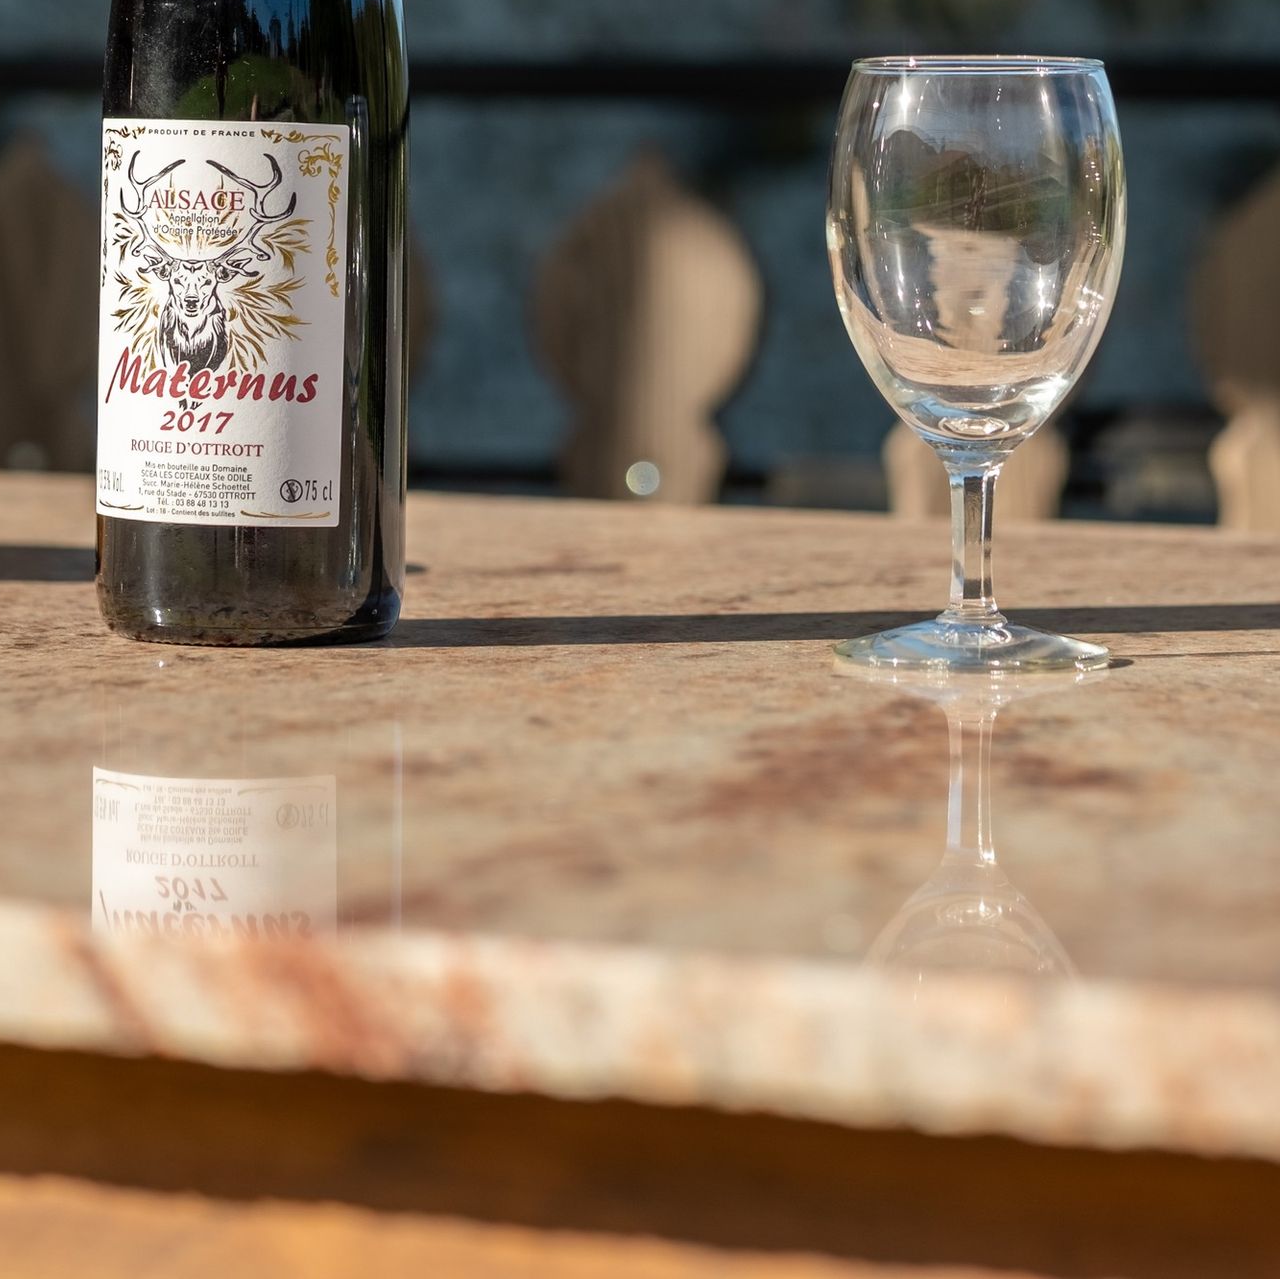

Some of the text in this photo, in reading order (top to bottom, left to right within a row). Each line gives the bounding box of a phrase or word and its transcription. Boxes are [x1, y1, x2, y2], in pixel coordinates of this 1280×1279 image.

[148, 190, 245, 211] ALSACE
[169, 214, 219, 224] Appellation
[197, 226, 237, 238] Protégée
[105, 345, 319, 403] Maternus
[160, 411, 234, 434] 2017
[131, 439, 172, 453] ROUGE
[168, 462, 199, 471] bouteille
[212, 464, 247, 473] Domaine
[160, 471, 172, 479] LES
[175, 472, 210, 481] COTEAUX
[161, 480, 210, 490] Marie-Hélène
[212, 483, 250, 491] Schoettel
[305, 480, 332, 501] 75 cl
[167, 489, 186, 498] Stade
[194, 491, 216, 499] 67530
[219, 492, 256, 500] OTTROTT
[186, 499, 195, 507] 88
[209, 500, 217, 508] 13
